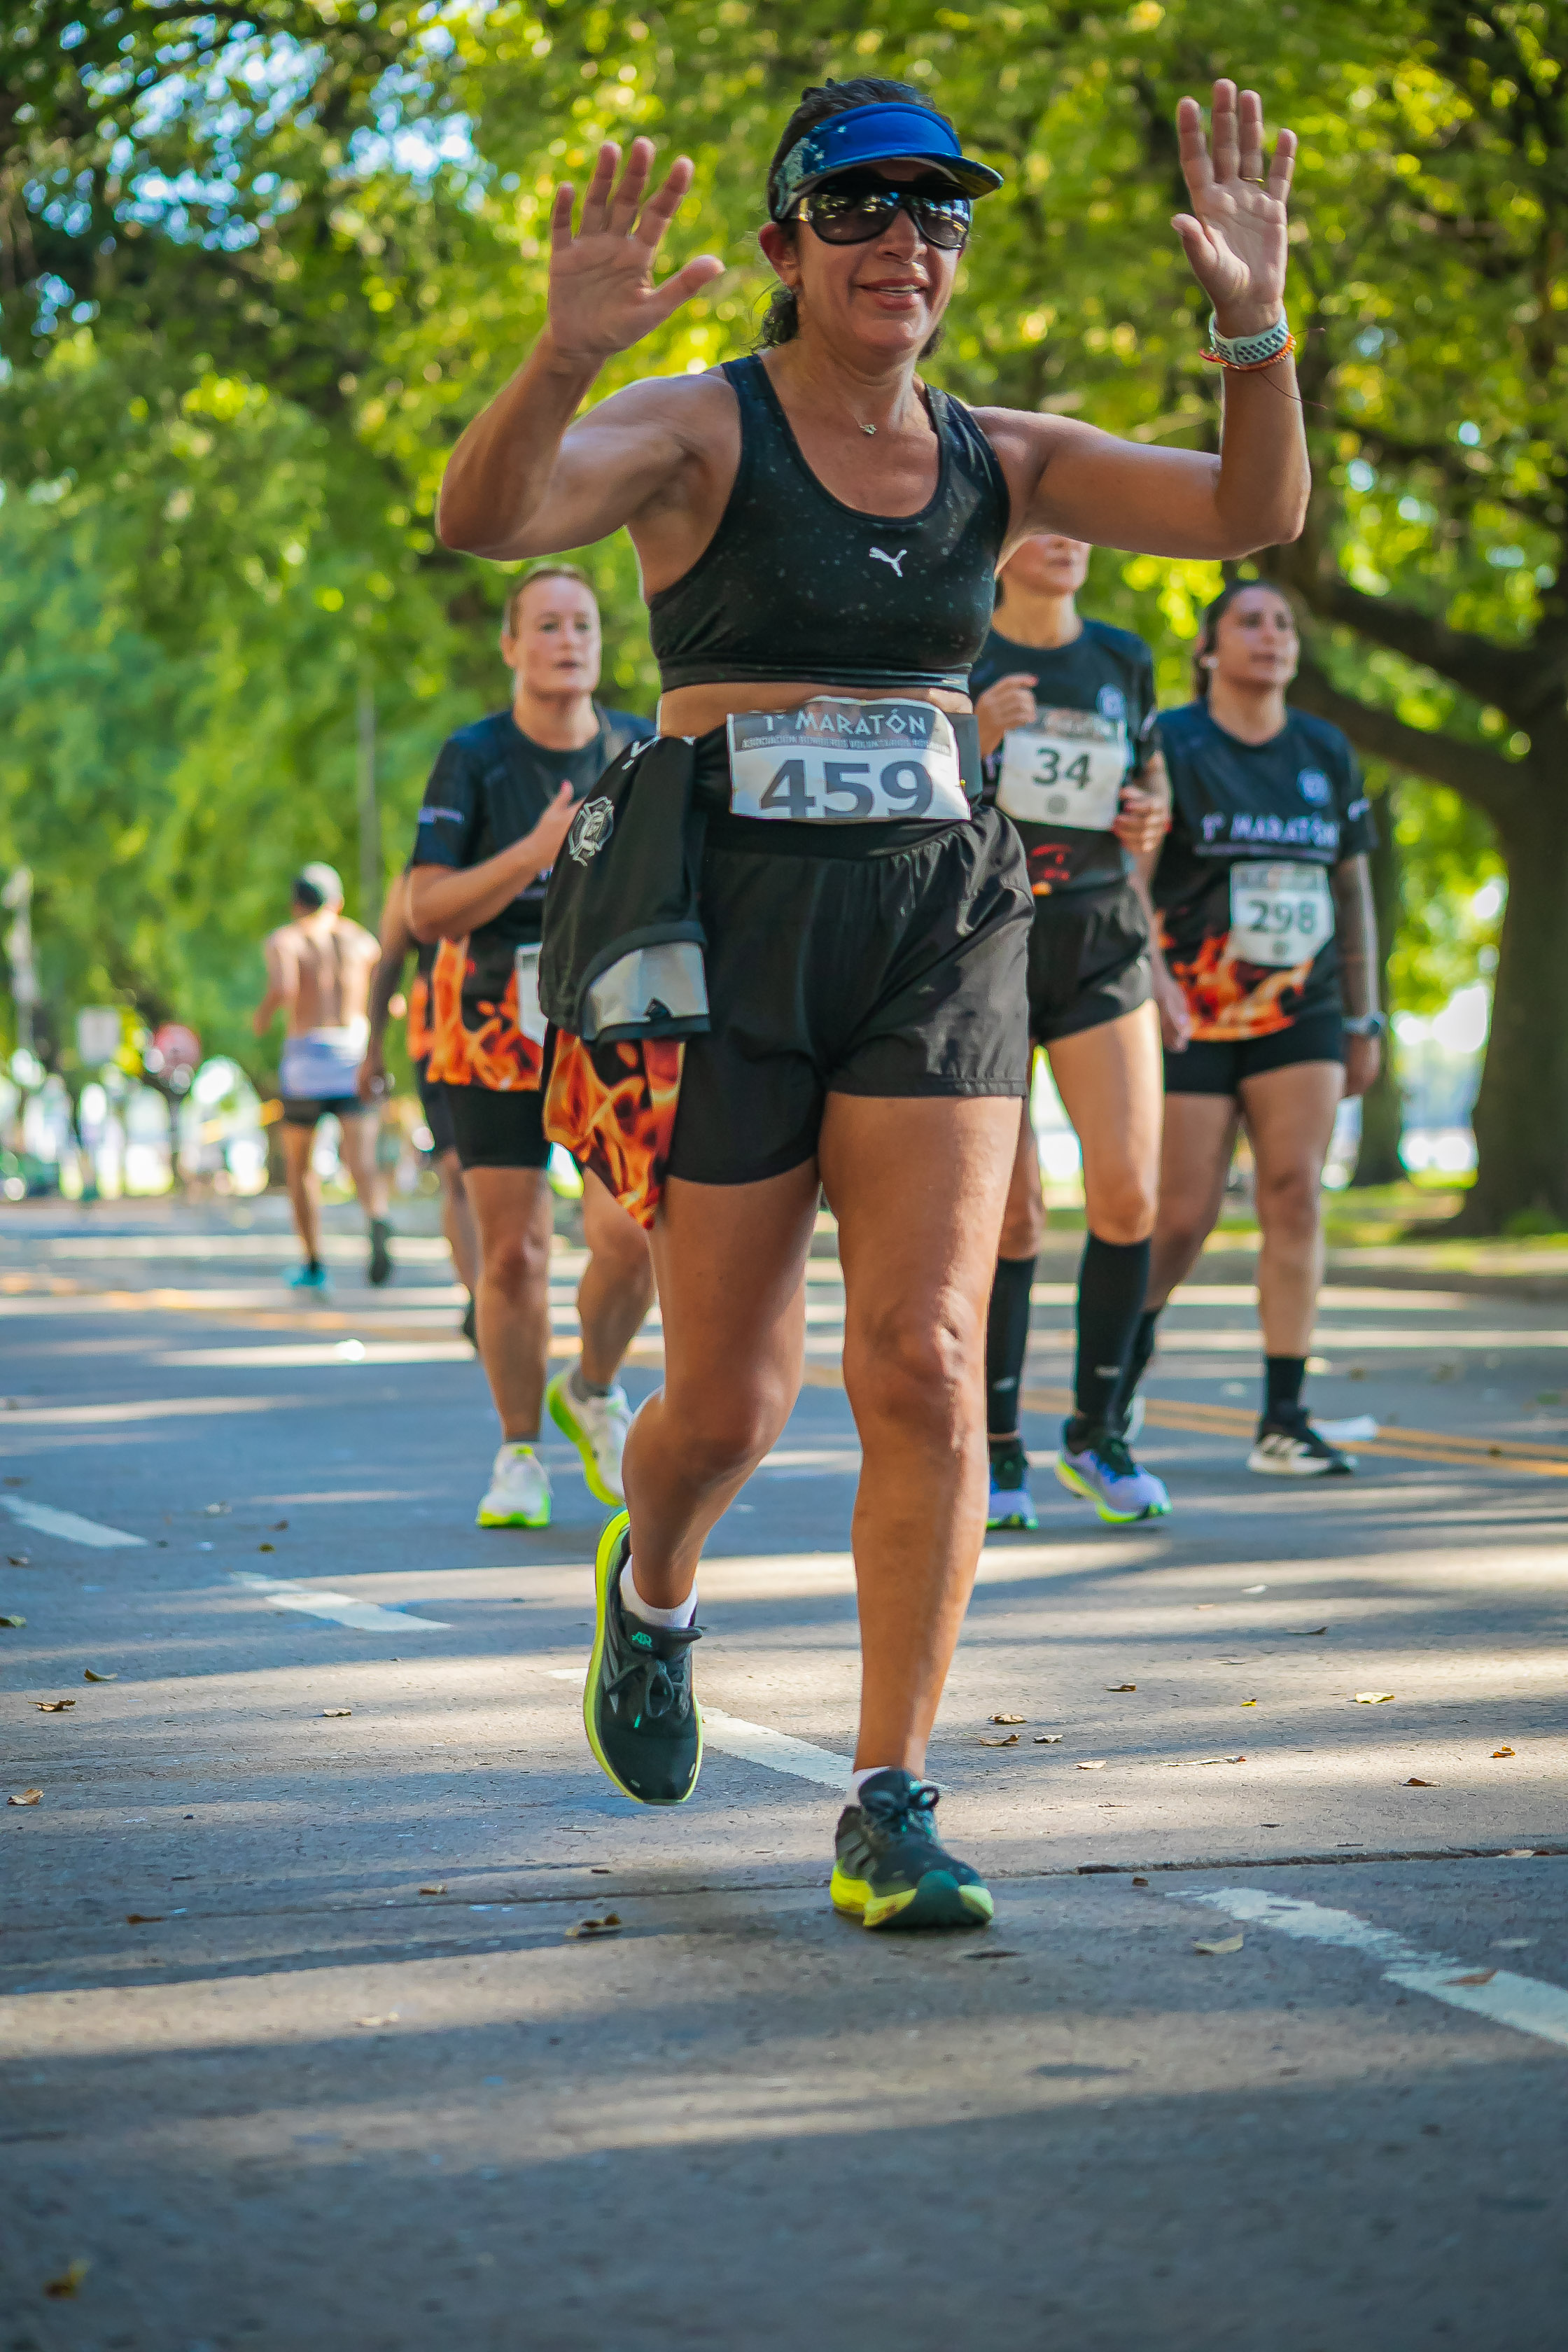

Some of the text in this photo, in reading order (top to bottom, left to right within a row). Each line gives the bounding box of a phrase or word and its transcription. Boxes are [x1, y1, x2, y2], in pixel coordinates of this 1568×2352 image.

[795, 708, 927, 735] MARATÓN
[1032, 747, 1091, 790] 34
[760, 760, 934, 818] 459
[1248, 899, 1317, 935] 298
